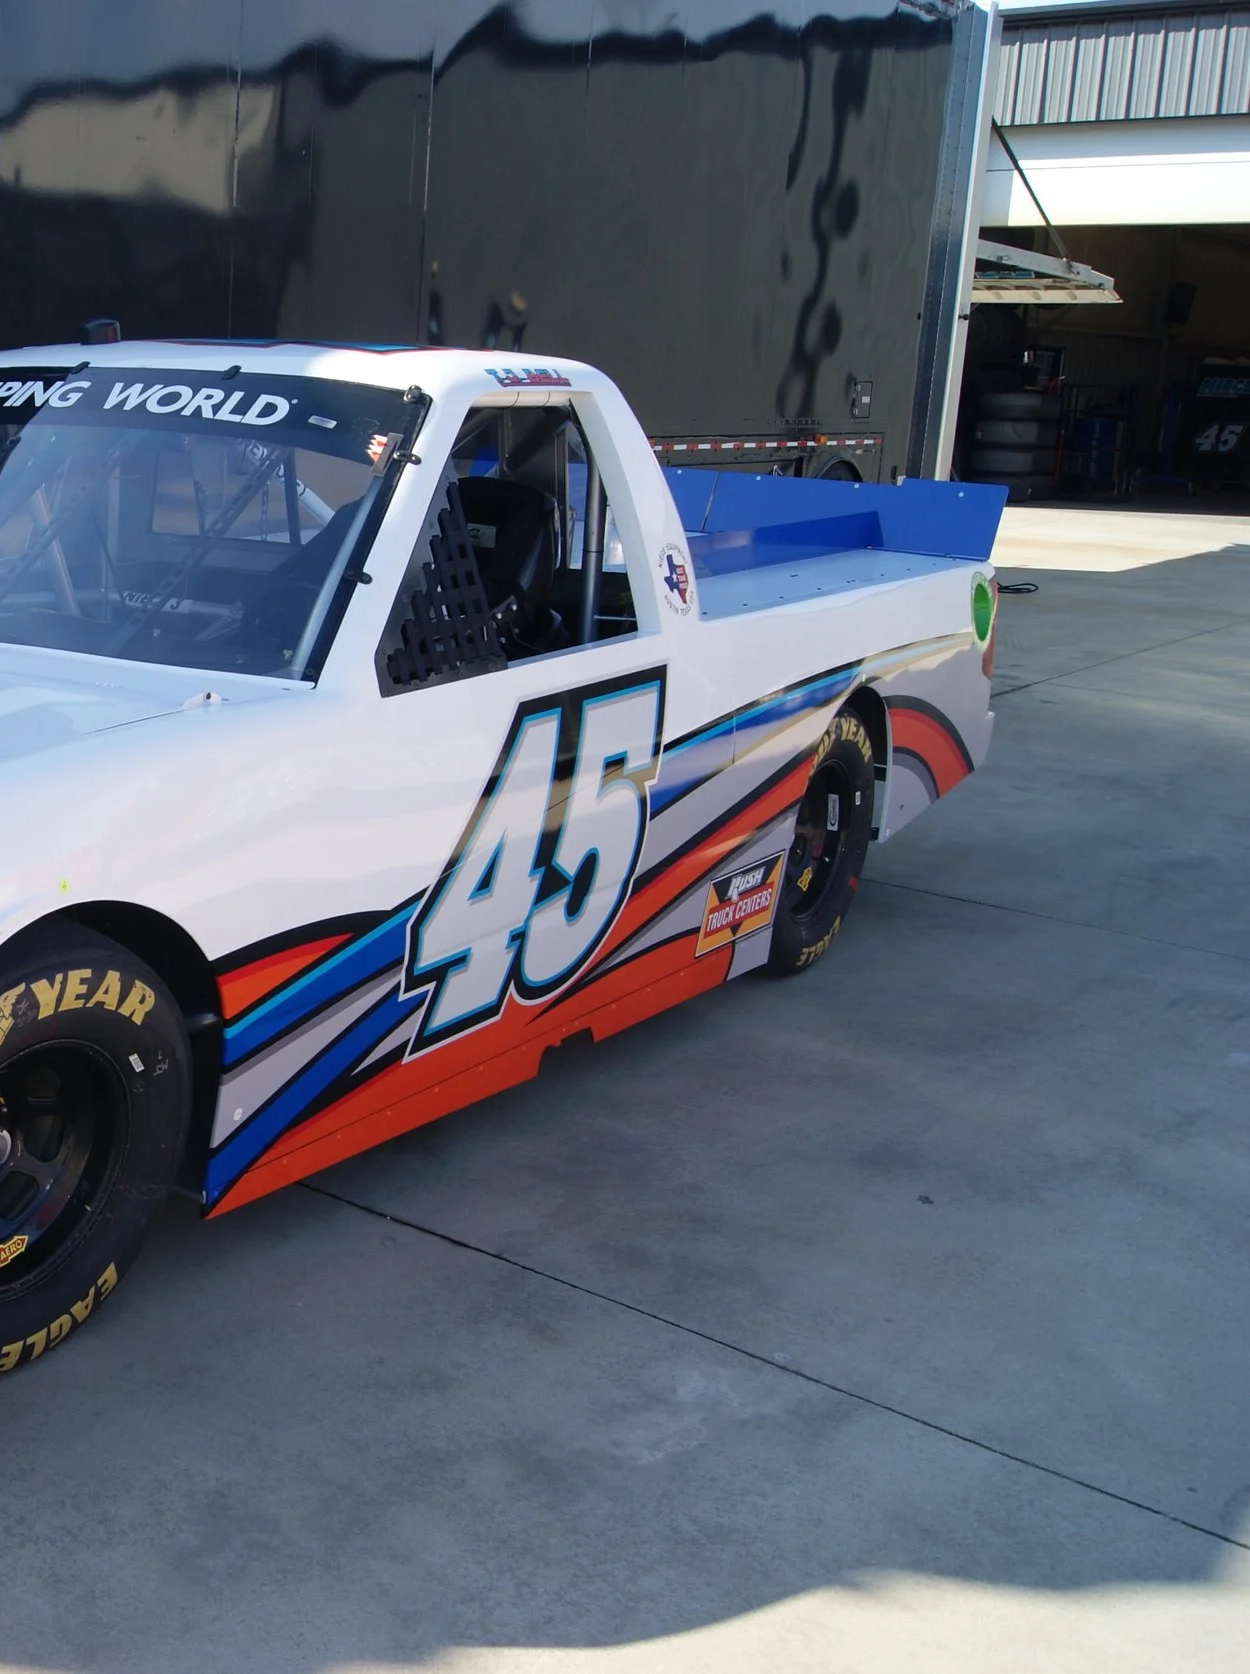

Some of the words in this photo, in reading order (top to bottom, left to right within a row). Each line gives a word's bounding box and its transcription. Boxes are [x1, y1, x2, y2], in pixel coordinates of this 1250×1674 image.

[103, 382, 293, 427] WORLD
[1194, 422, 1244, 454] 45
[408, 670, 665, 1050] 45
[725, 866, 766, 902] RUSH
[707, 904, 736, 933] TRUCK
[735, 888, 772, 920] CENTERS
[0, 1239, 23, 1262] AERO
